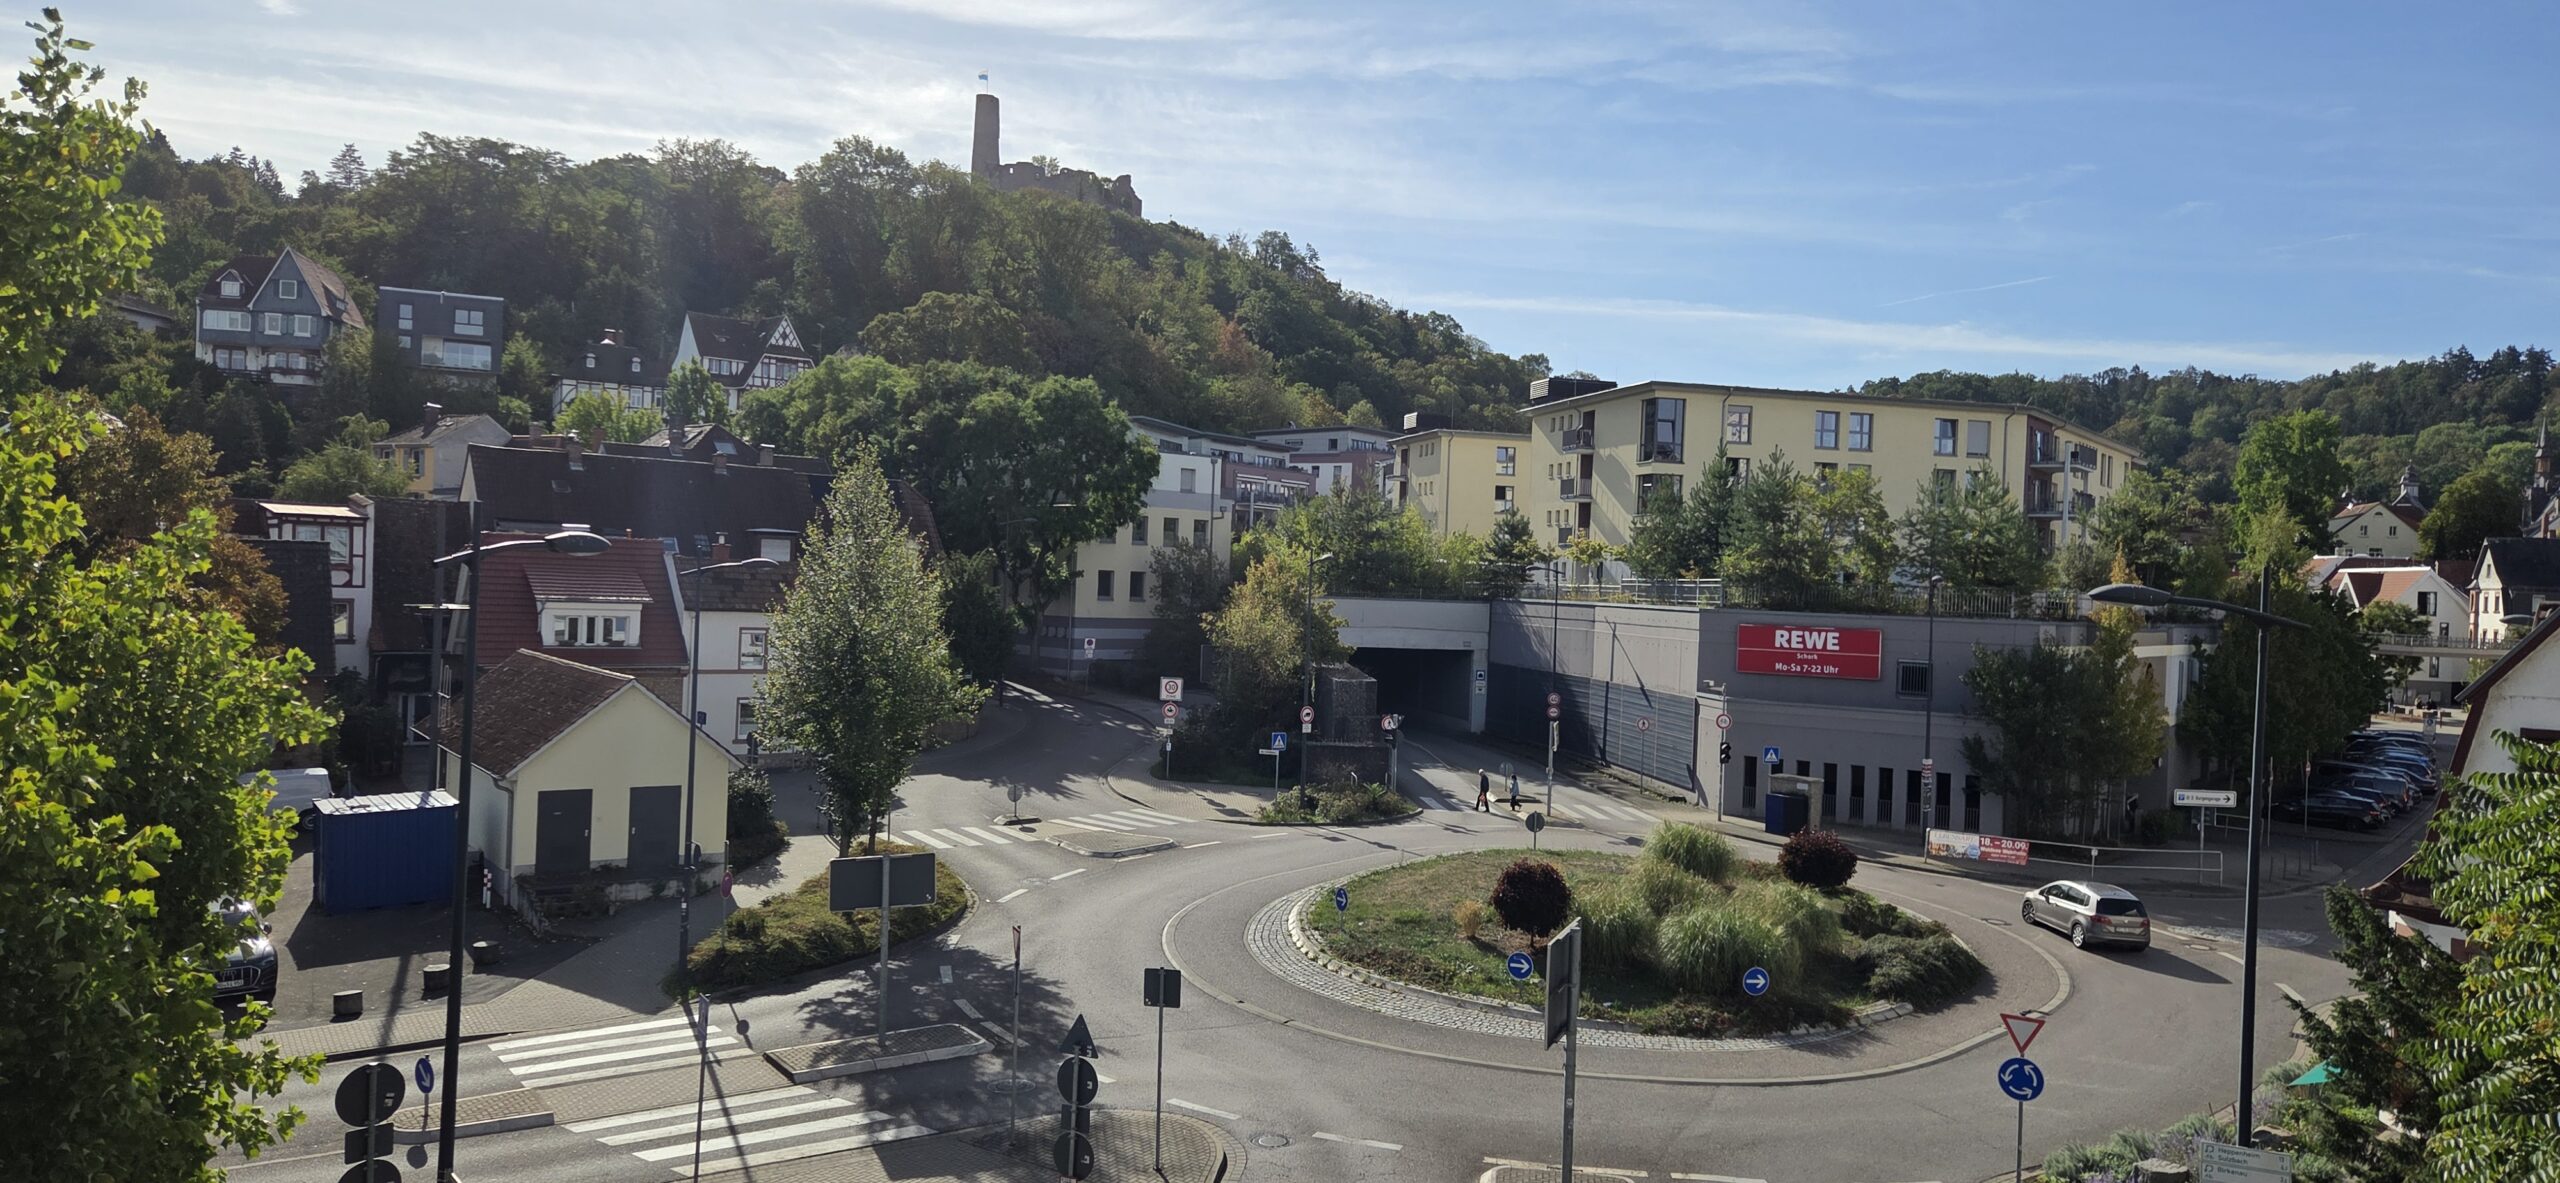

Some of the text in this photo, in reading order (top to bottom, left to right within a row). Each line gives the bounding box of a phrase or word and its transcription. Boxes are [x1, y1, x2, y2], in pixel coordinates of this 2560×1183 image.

[1774, 629, 1840, 651] REWE
[1775, 662, 1839, 674] Mo-Sa 7-22 Uhr
[2217, 1148, 2260, 1158] Heppenheim
[2217, 1155, 2249, 1165] Sulzbach
[2217, 1167, 2248, 1177] Birkenau
